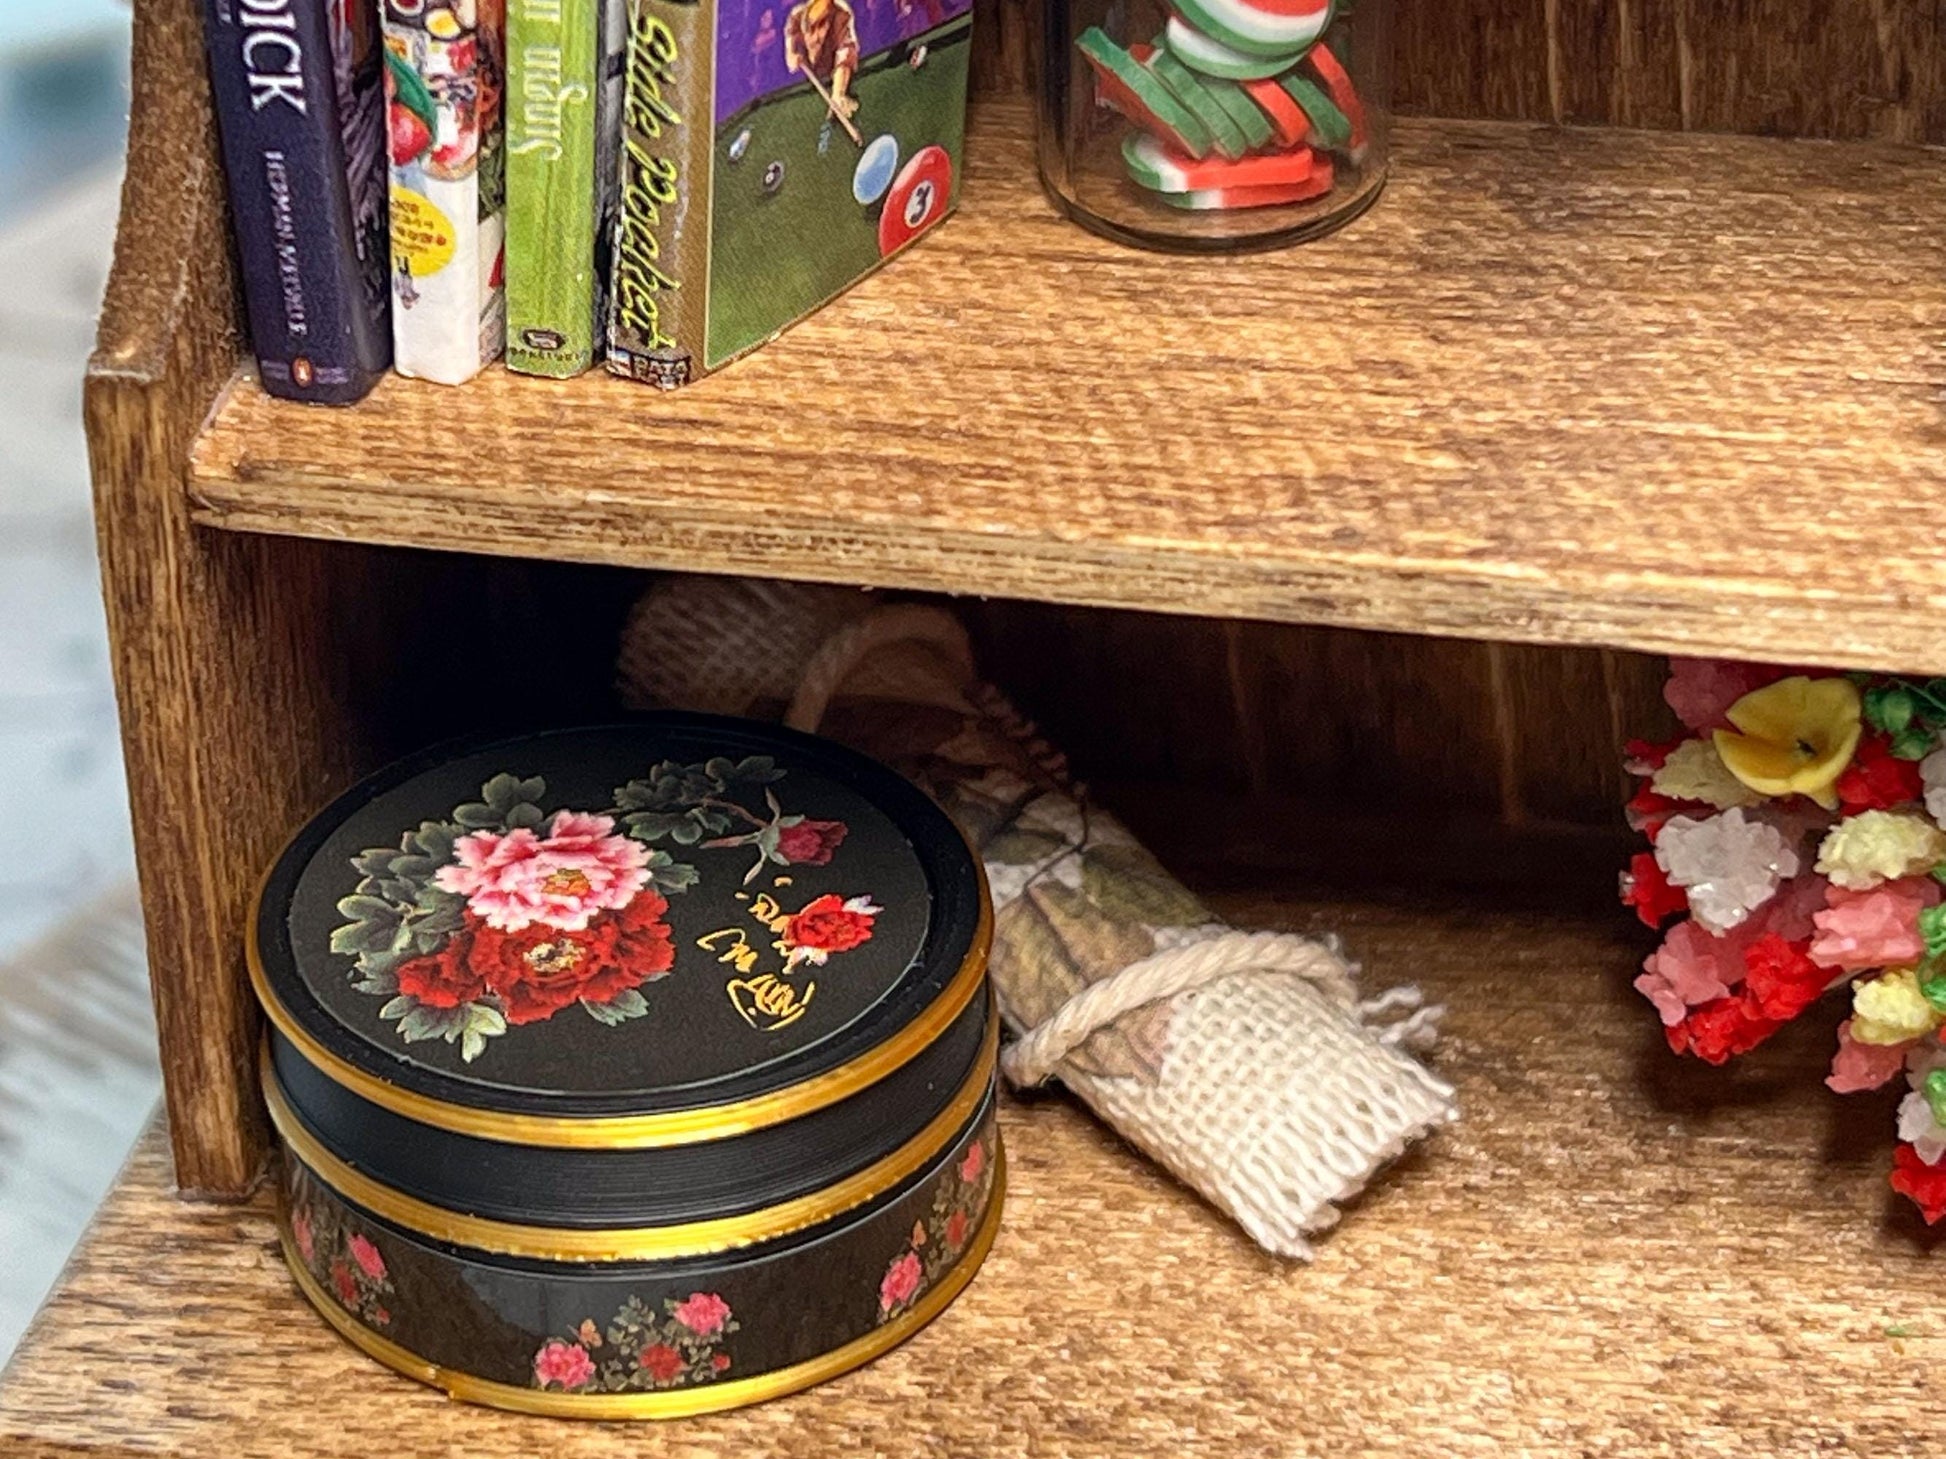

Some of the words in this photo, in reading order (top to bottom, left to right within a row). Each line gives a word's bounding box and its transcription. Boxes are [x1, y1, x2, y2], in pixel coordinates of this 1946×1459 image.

[239, 0, 307, 115] ICK
[625, 16, 681, 138] Side
[620, 139, 683, 350] Pocket
[908, 183, 932, 225] 3
